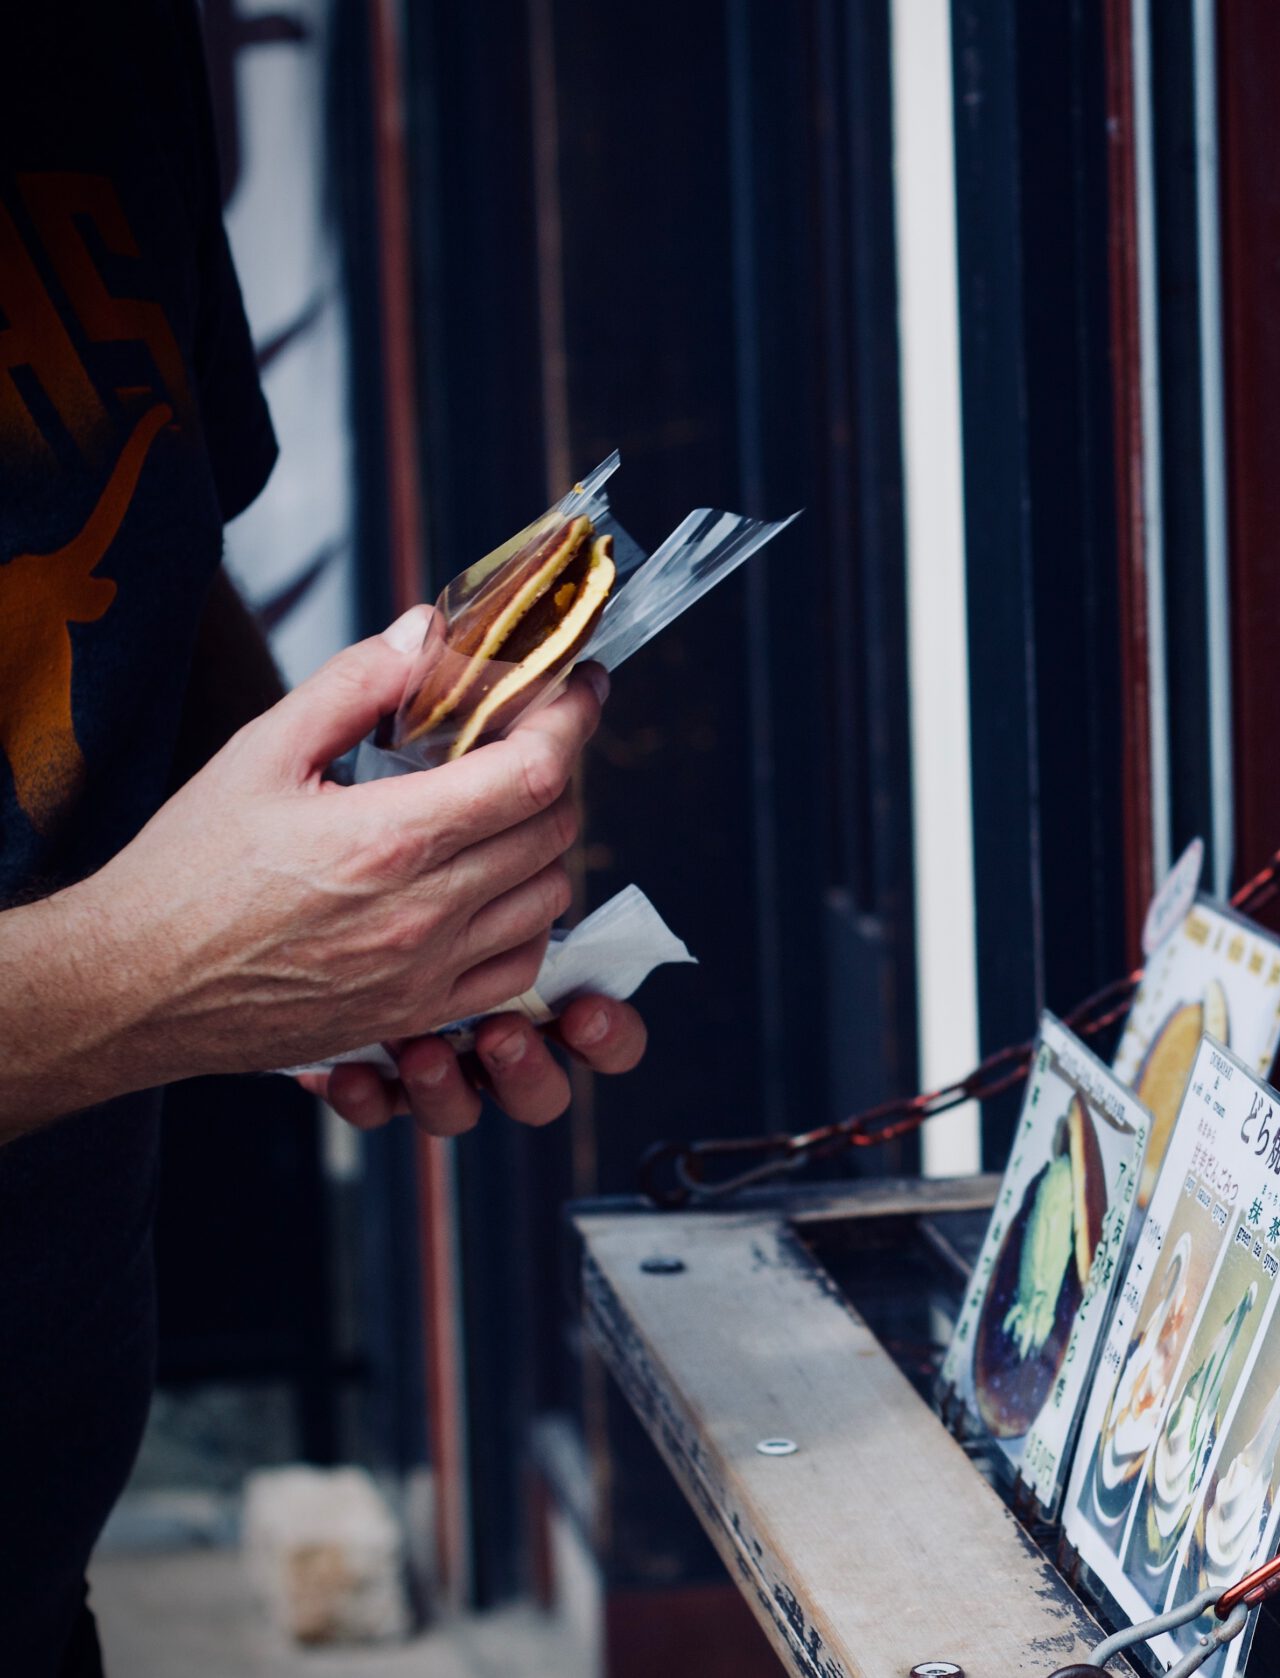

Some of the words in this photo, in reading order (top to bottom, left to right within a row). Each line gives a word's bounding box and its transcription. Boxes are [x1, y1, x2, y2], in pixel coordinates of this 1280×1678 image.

[1236, 1226, 1251, 1247] green
[1252, 1241, 1263, 1258] tea
[1263, 1252, 1279, 1277] syrup
